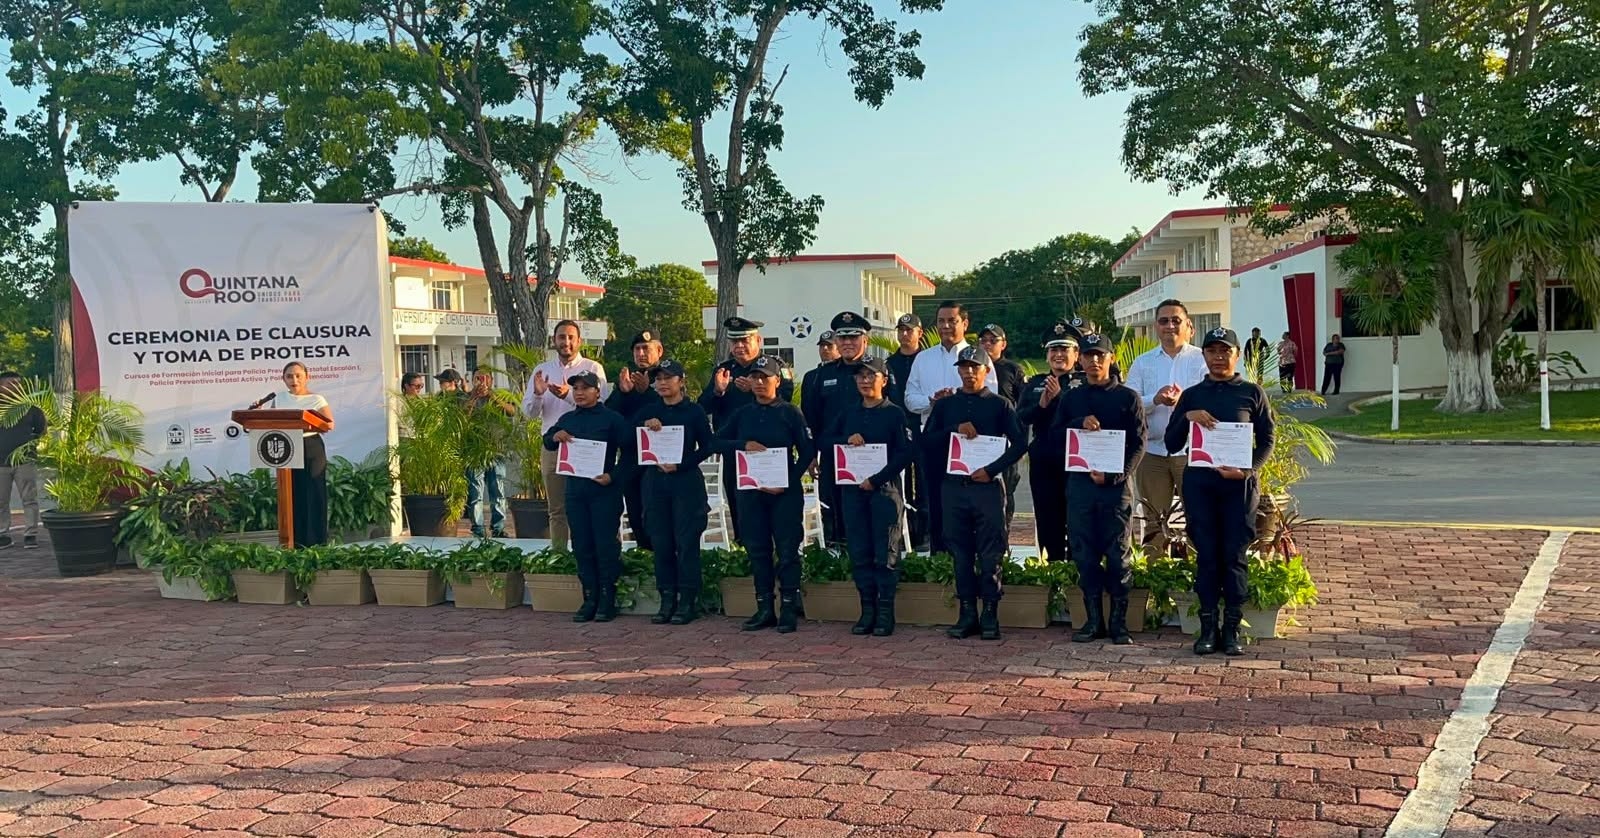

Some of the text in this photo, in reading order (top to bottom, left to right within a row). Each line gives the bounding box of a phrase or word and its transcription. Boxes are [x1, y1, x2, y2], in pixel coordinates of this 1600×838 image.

[180, 268, 299, 298] QUINTANA
[215, 290, 256, 304] ROO
[393, 311, 433, 324] NIVERSIDAD
[446, 314, 473, 326] CIENCIAS
[480, 316, 497, 327] DISCIP
[108, 325, 371, 345] CEREMONIA DE CLAUSURA
[133, 345, 350, 364] Y TOMA DE PROTESTA
[162, 370, 200, 378] Formación
[202, 369, 224, 377] Inicial
[224, 370, 242, 378] para
[215, 376, 240, 384] Estatal
